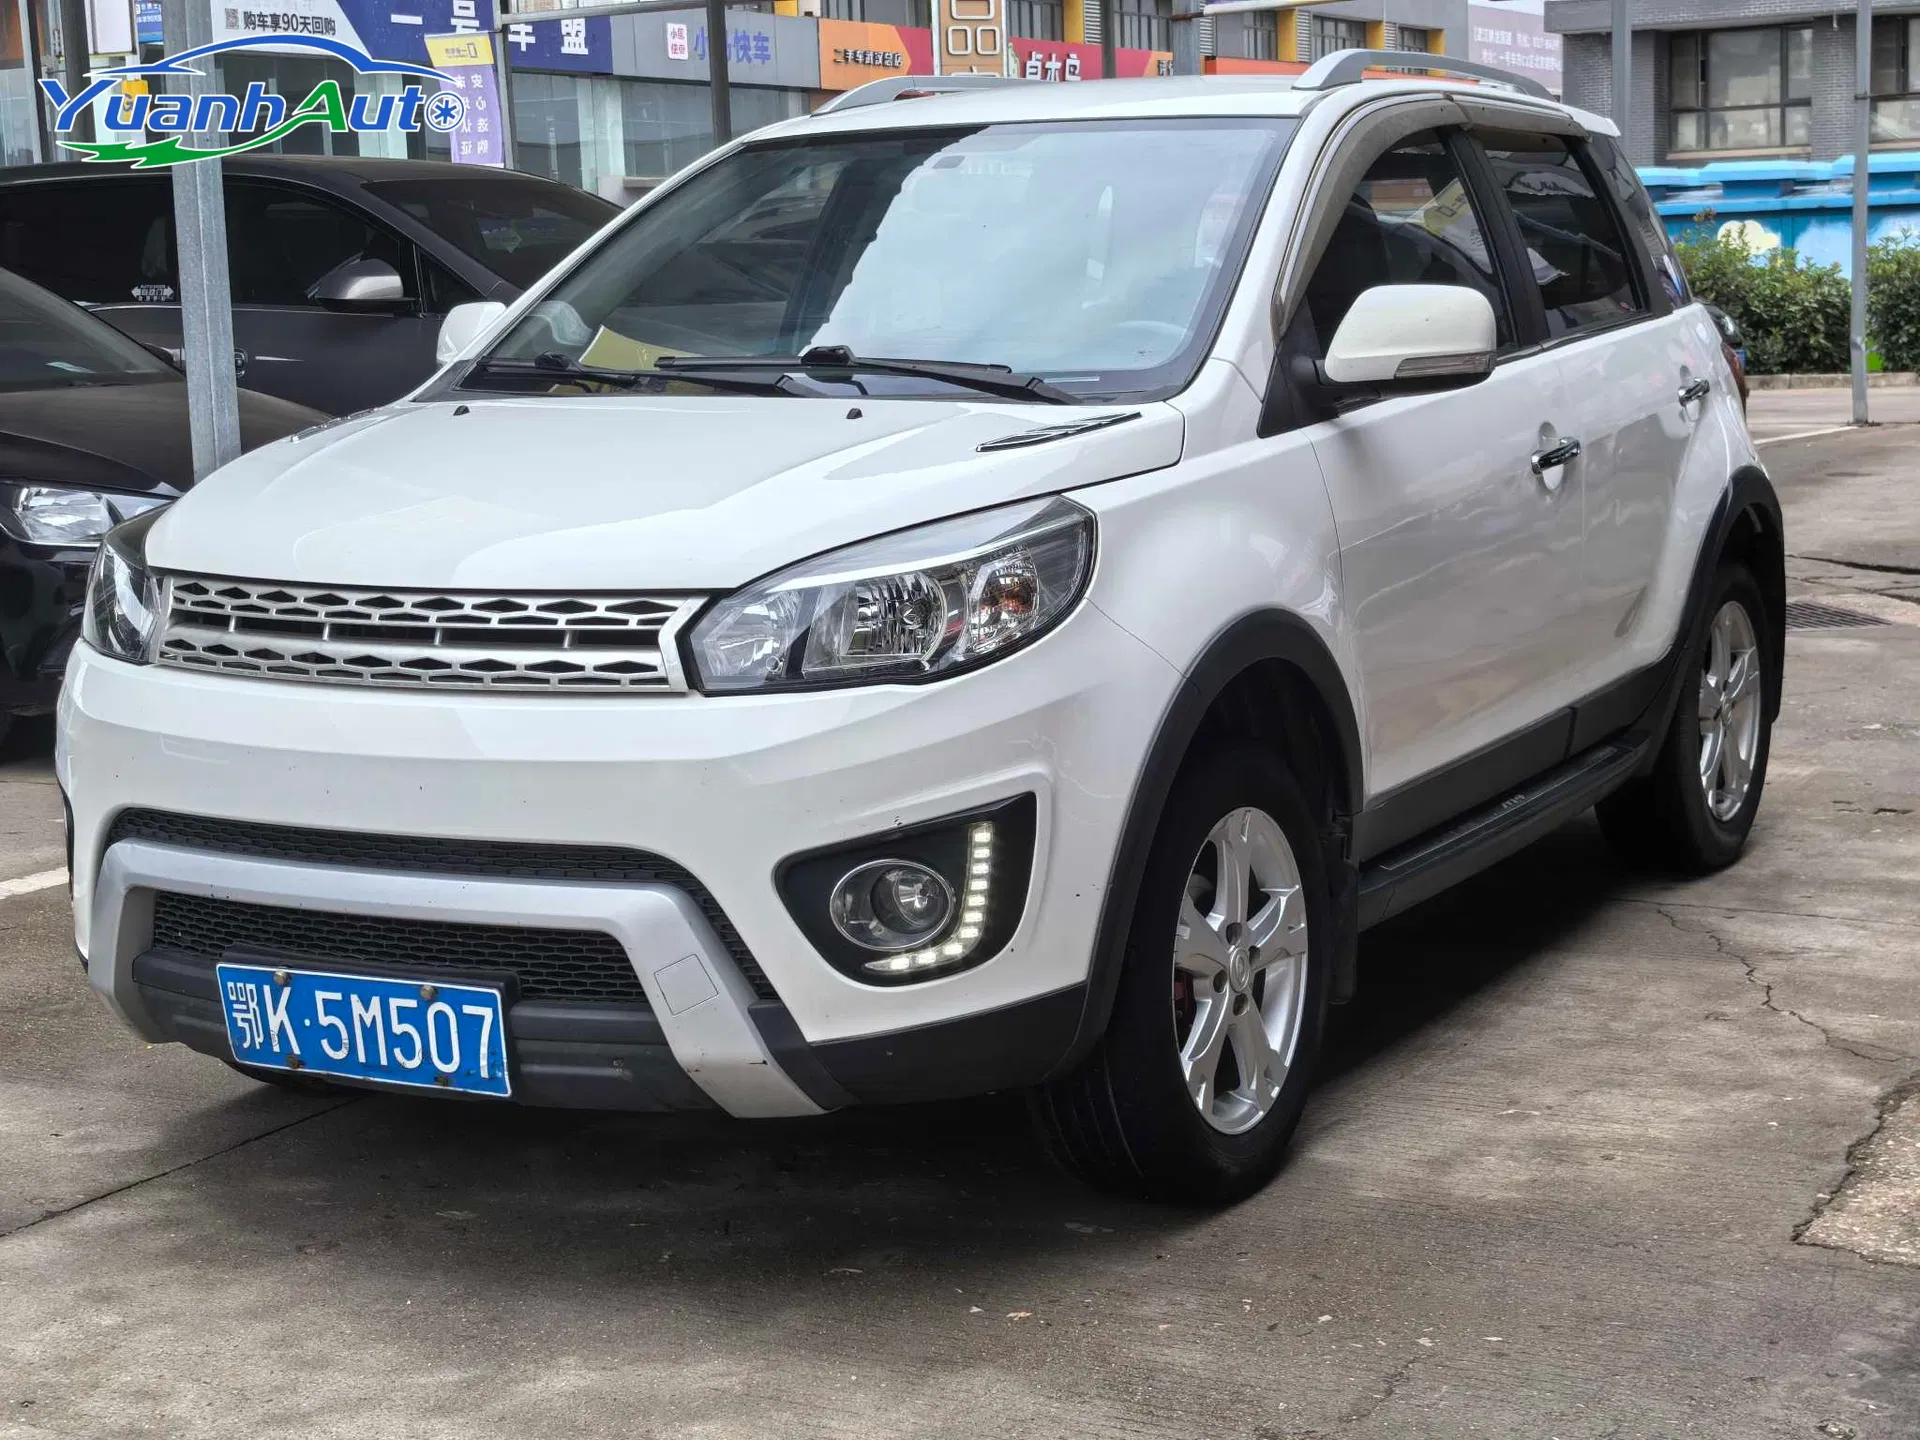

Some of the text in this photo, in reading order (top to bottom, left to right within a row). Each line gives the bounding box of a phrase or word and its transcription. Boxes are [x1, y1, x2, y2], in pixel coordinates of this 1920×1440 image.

[243, 11, 336, 36] 购车享90天回购
[694, 26, 771, 65] 小快车
